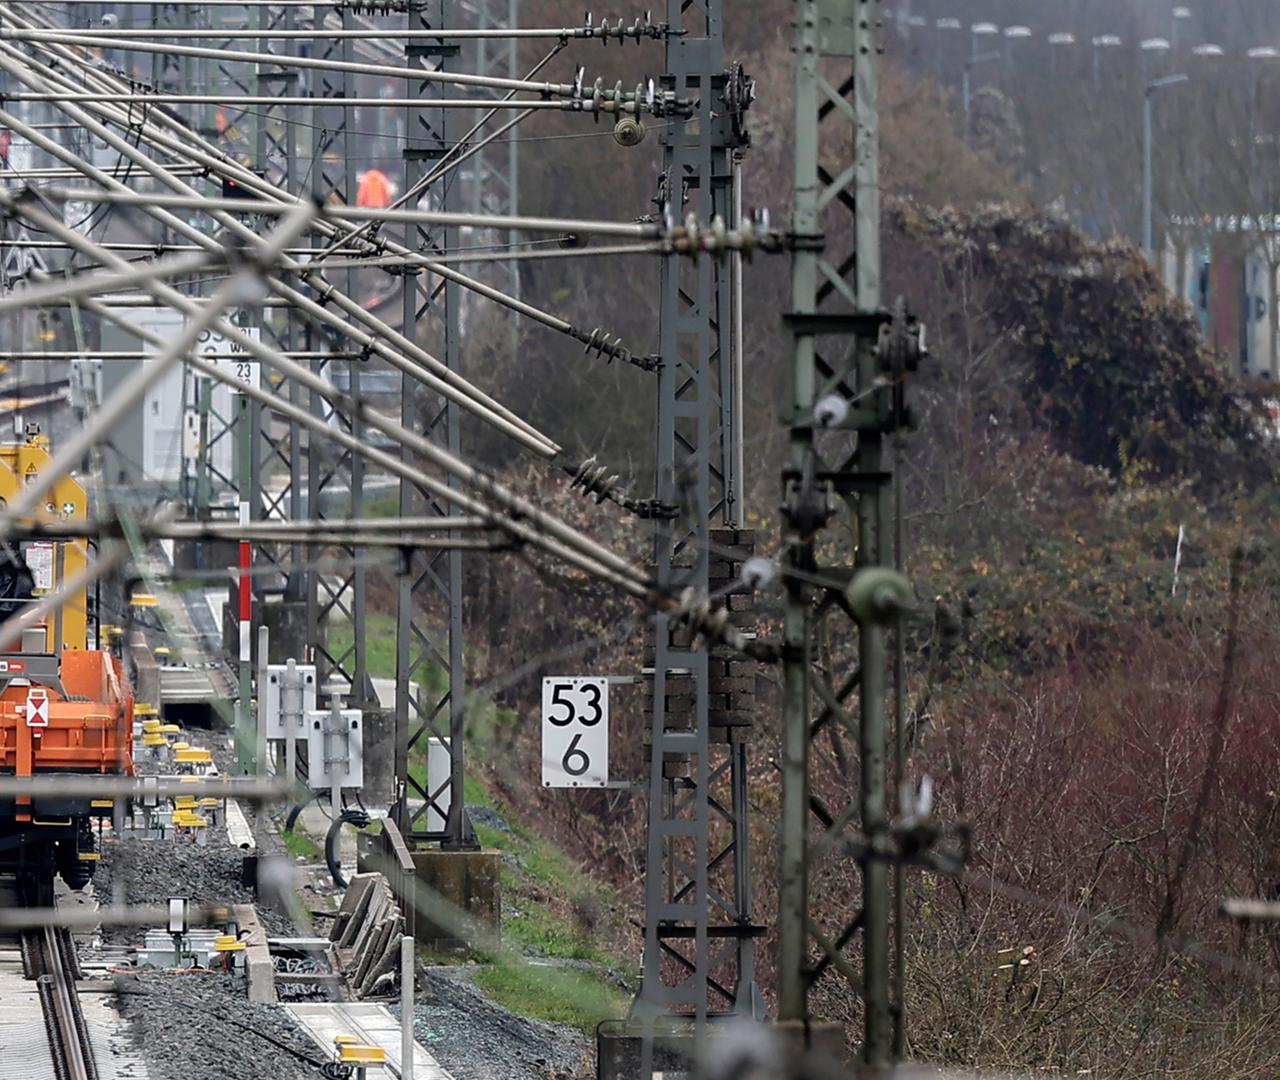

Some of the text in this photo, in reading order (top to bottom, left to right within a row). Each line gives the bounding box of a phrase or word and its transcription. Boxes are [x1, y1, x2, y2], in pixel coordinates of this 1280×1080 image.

[237, 363, 251, 378] 23
[548, 684, 602, 727] 53
[562, 733, 590, 776] 6
